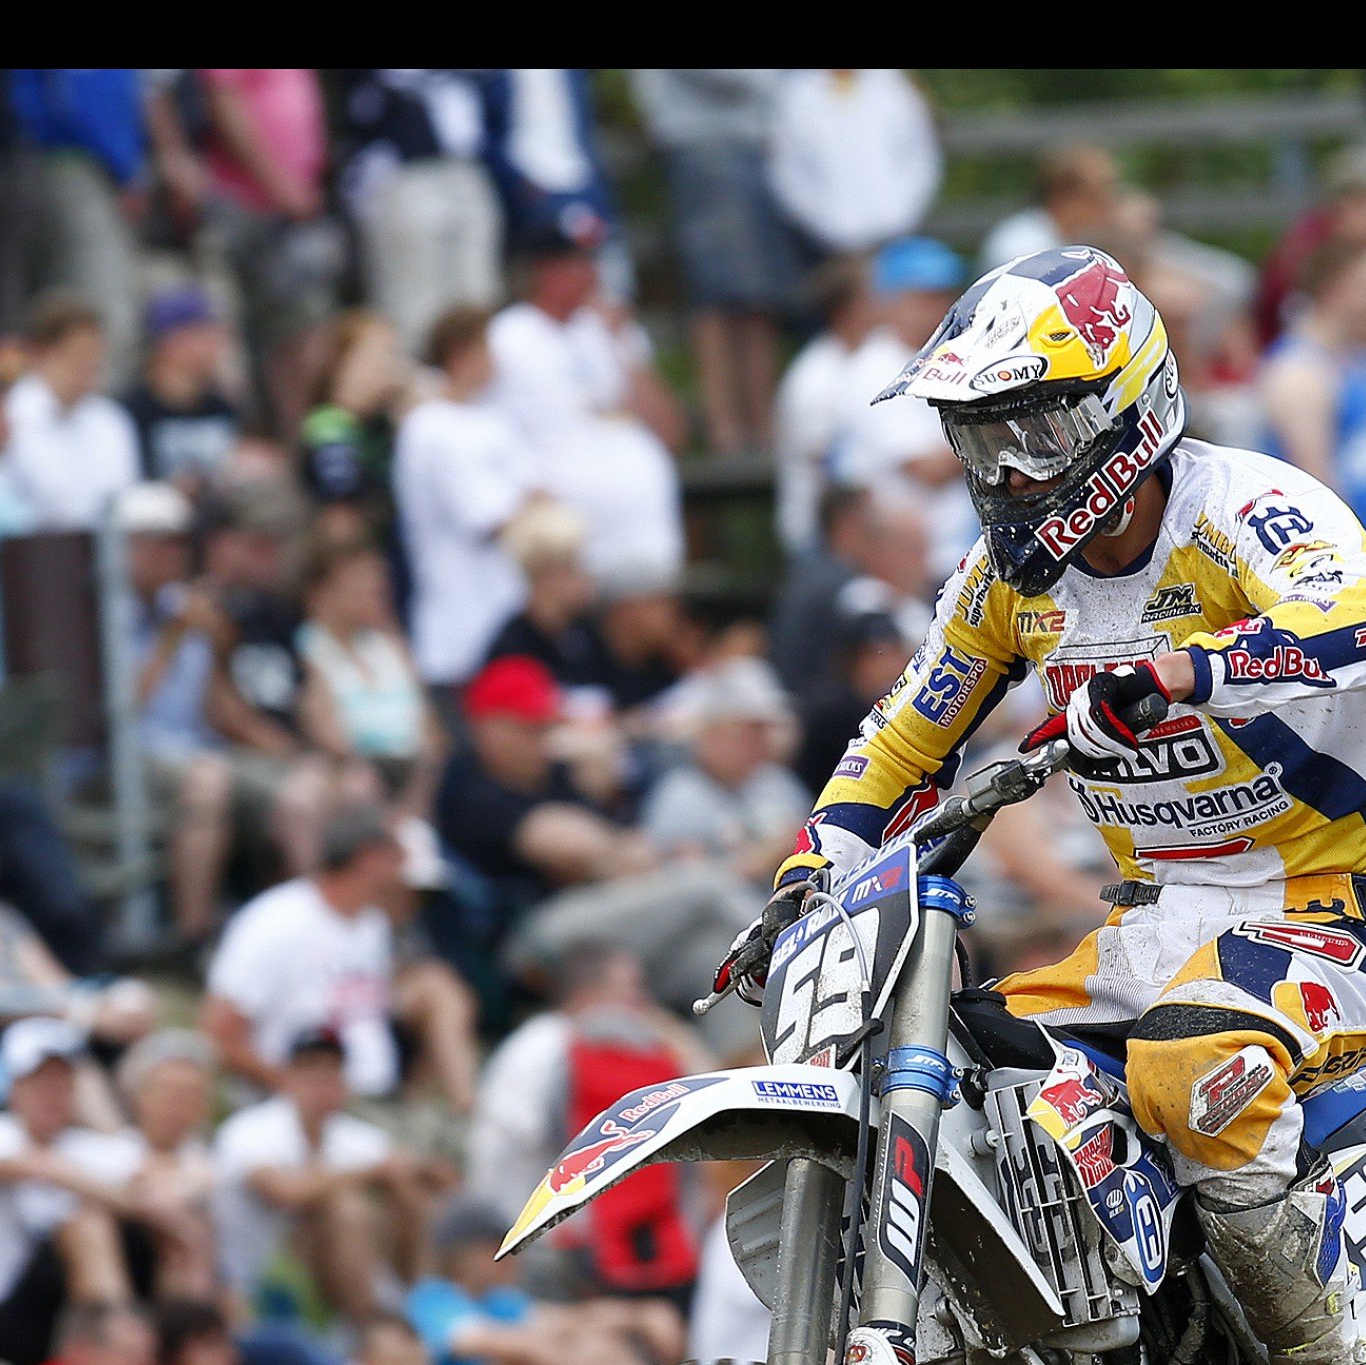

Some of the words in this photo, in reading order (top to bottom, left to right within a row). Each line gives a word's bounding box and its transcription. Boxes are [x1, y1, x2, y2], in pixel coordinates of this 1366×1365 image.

[1037, 473, 1118, 560] Red
[1103, 411, 1165, 494] Bull
[911, 646, 977, 724] EST
[941, 658, 986, 728] MOTORSPO
[1229, 647, 1283, 679] Red
[1284, 647, 1329, 680] Bu
[1095, 775, 1282, 830] Husqvarna
[1189, 815, 1242, 838] FACTORY
[1243, 800, 1289, 827] RACING
[771, 907, 881, 1067] 59
[753, 1081, 837, 1100] LEMMENS
